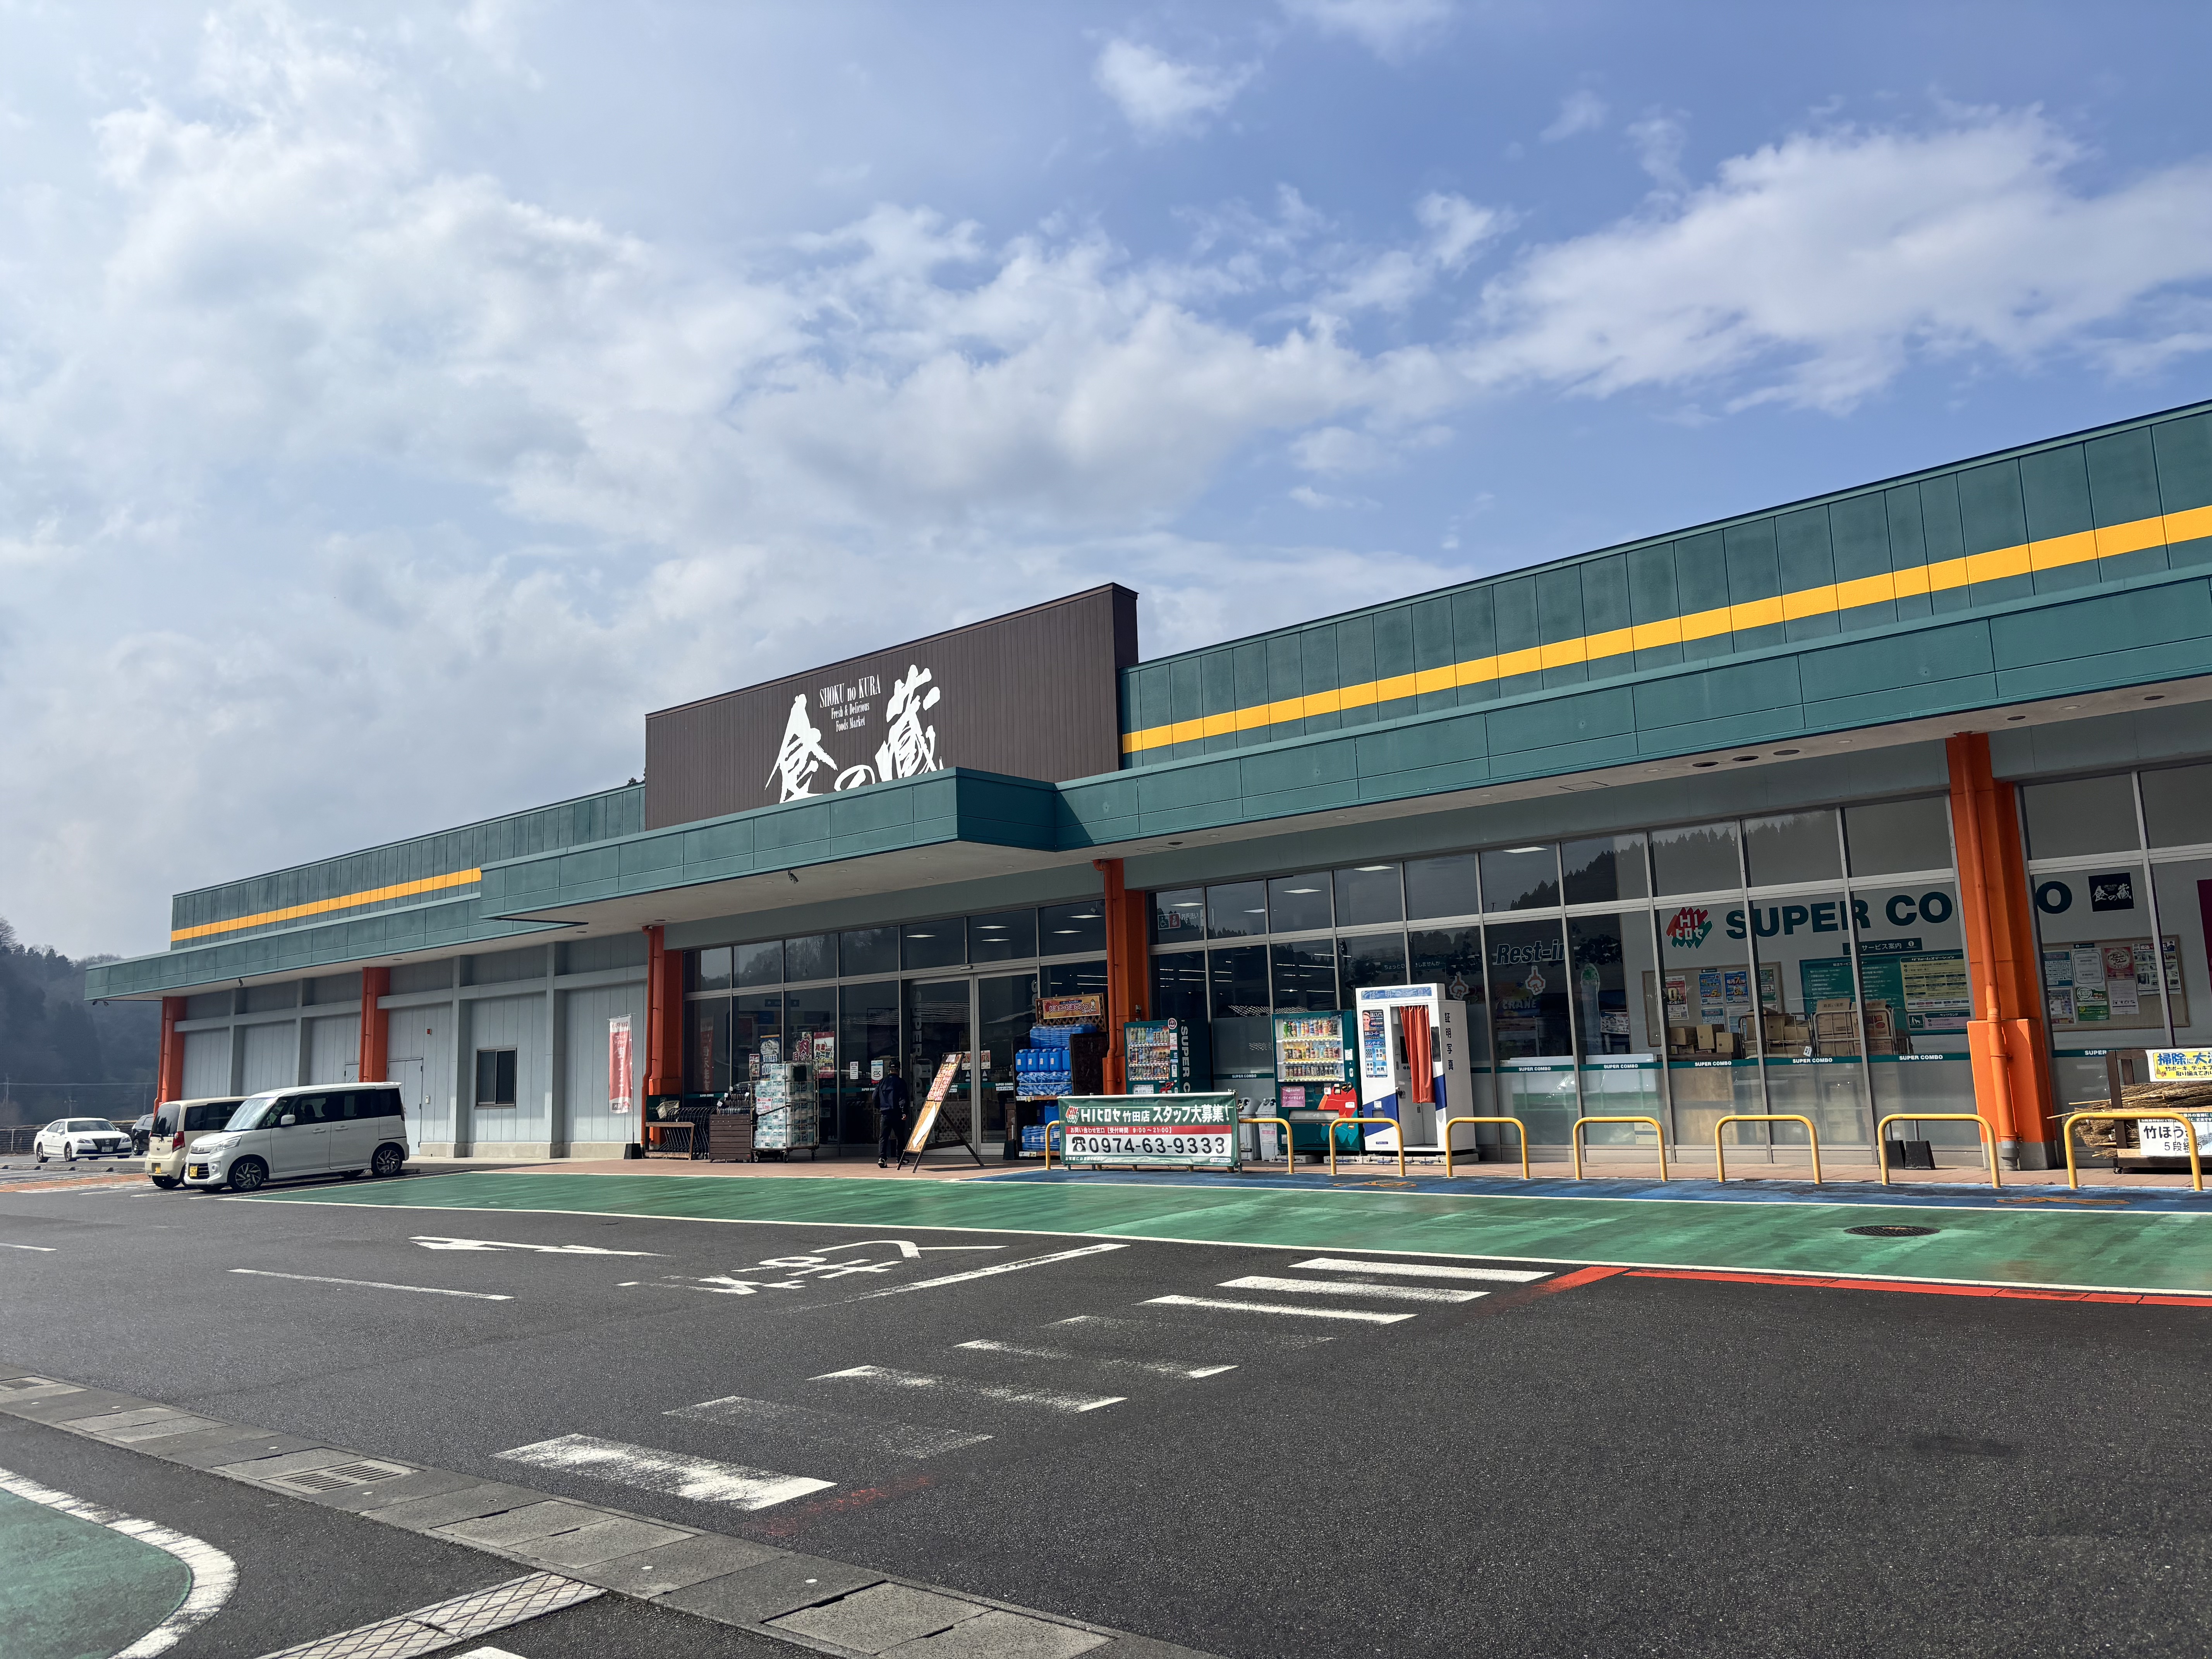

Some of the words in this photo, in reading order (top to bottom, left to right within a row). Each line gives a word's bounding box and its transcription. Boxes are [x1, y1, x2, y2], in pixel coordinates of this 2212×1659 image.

[819, 683, 845, 708] SHOKU
[847, 687, 856, 702] no
[859, 674, 881, 699] KURA
[831, 706, 843, 720] Fresh
[844, 704, 848, 716] &
[849, 701, 870, 715] Delicious
[836, 719, 848, 732] Foods
[849, 715, 866, 729] Market
[1726, 899, 1871, 939] SUPER
[1885, 881, 2073, 926] COO
[1680, 914, 1698, 927] HI
[1676, 927, 1704, 940] ヒロセ
[1862, 943, 1902, 951] サービス案内
[1384, 961, 1441, 970] ちょっとひしませんか
[1444, 1012, 1454, 1070] 証明写真
[1181, 1026, 1190, 1077] SUPER
[1081, 1108, 1121, 1122] HIヒロセ
[1123, 1110, 1150, 1122] 竹田店
[1152, 1104, 1230, 1123] スタッフ大募集!
[2143, 1125, 2188, 1139] 竹ほう
[1089, 1137, 1225, 1154] 0974-63-9333
